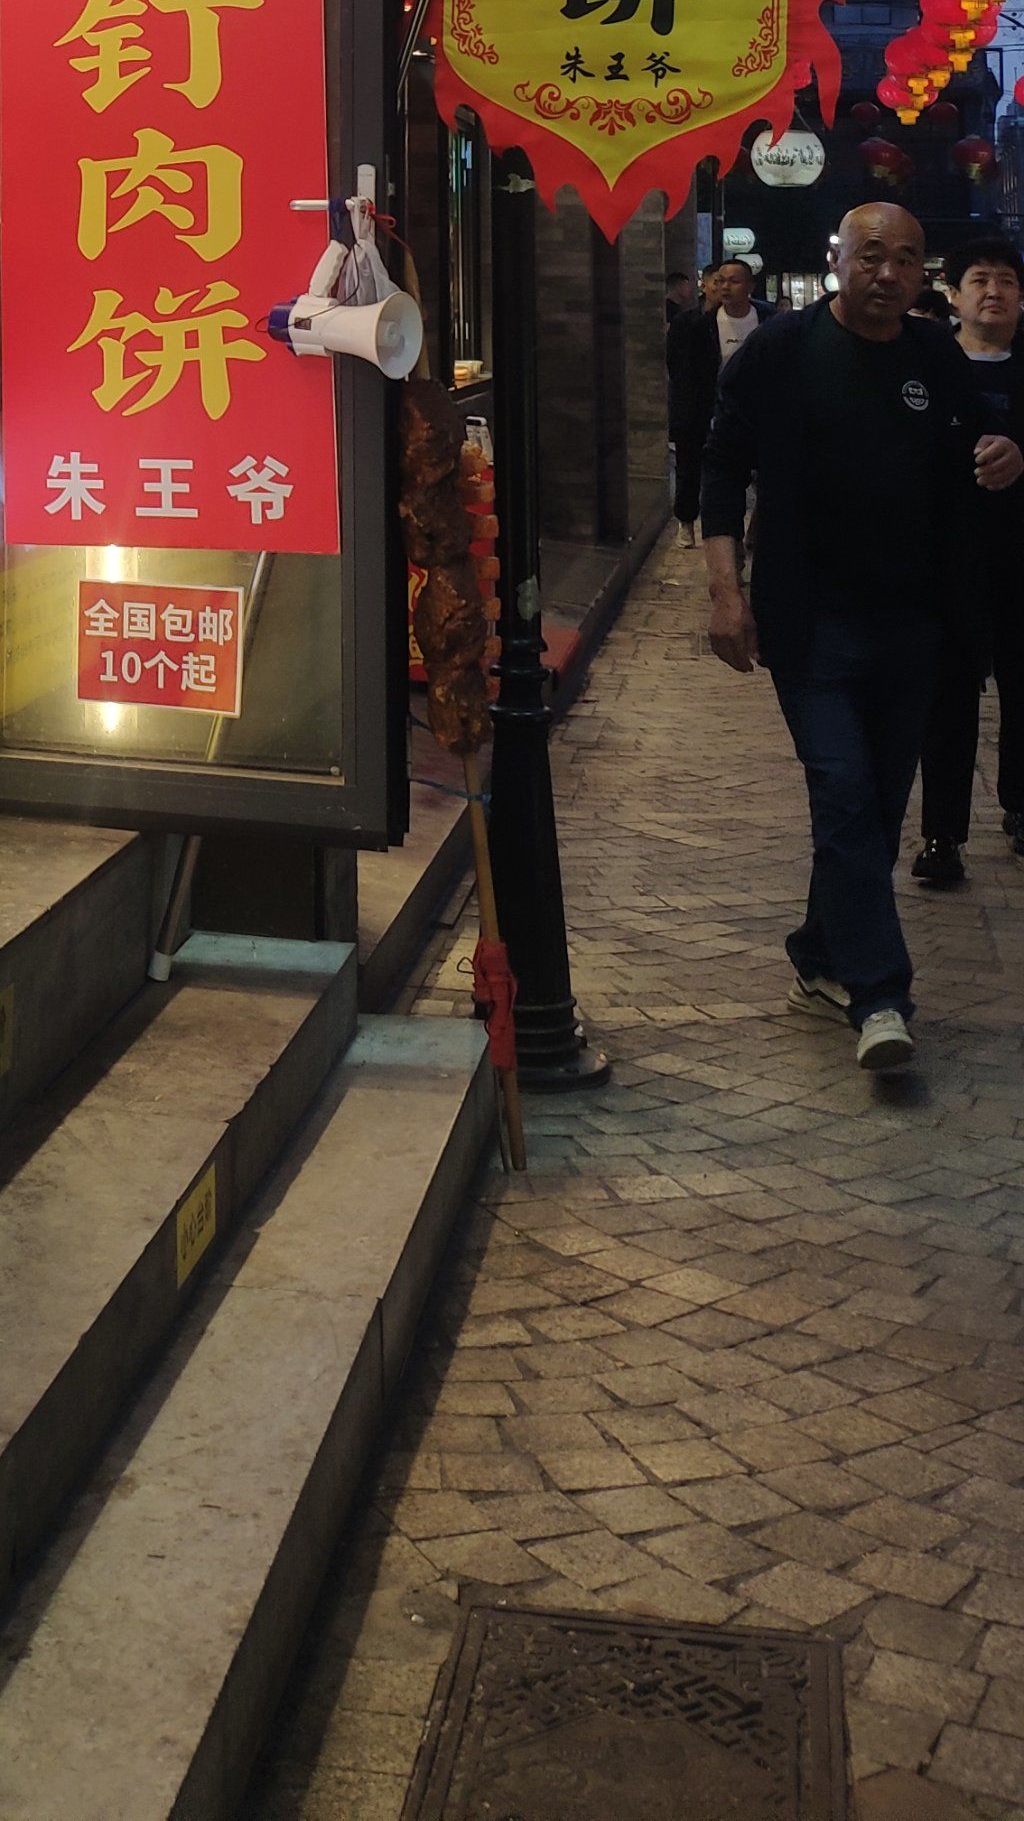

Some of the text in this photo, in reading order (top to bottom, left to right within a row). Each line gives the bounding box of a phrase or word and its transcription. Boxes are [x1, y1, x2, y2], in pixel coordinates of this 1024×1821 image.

[559, 46, 681, 89] 朱王爷
[44, 451, 293, 524] 朱王爷
[83, 600, 233, 647] 全国包邮
[99, 650, 217, 694] 10个起
